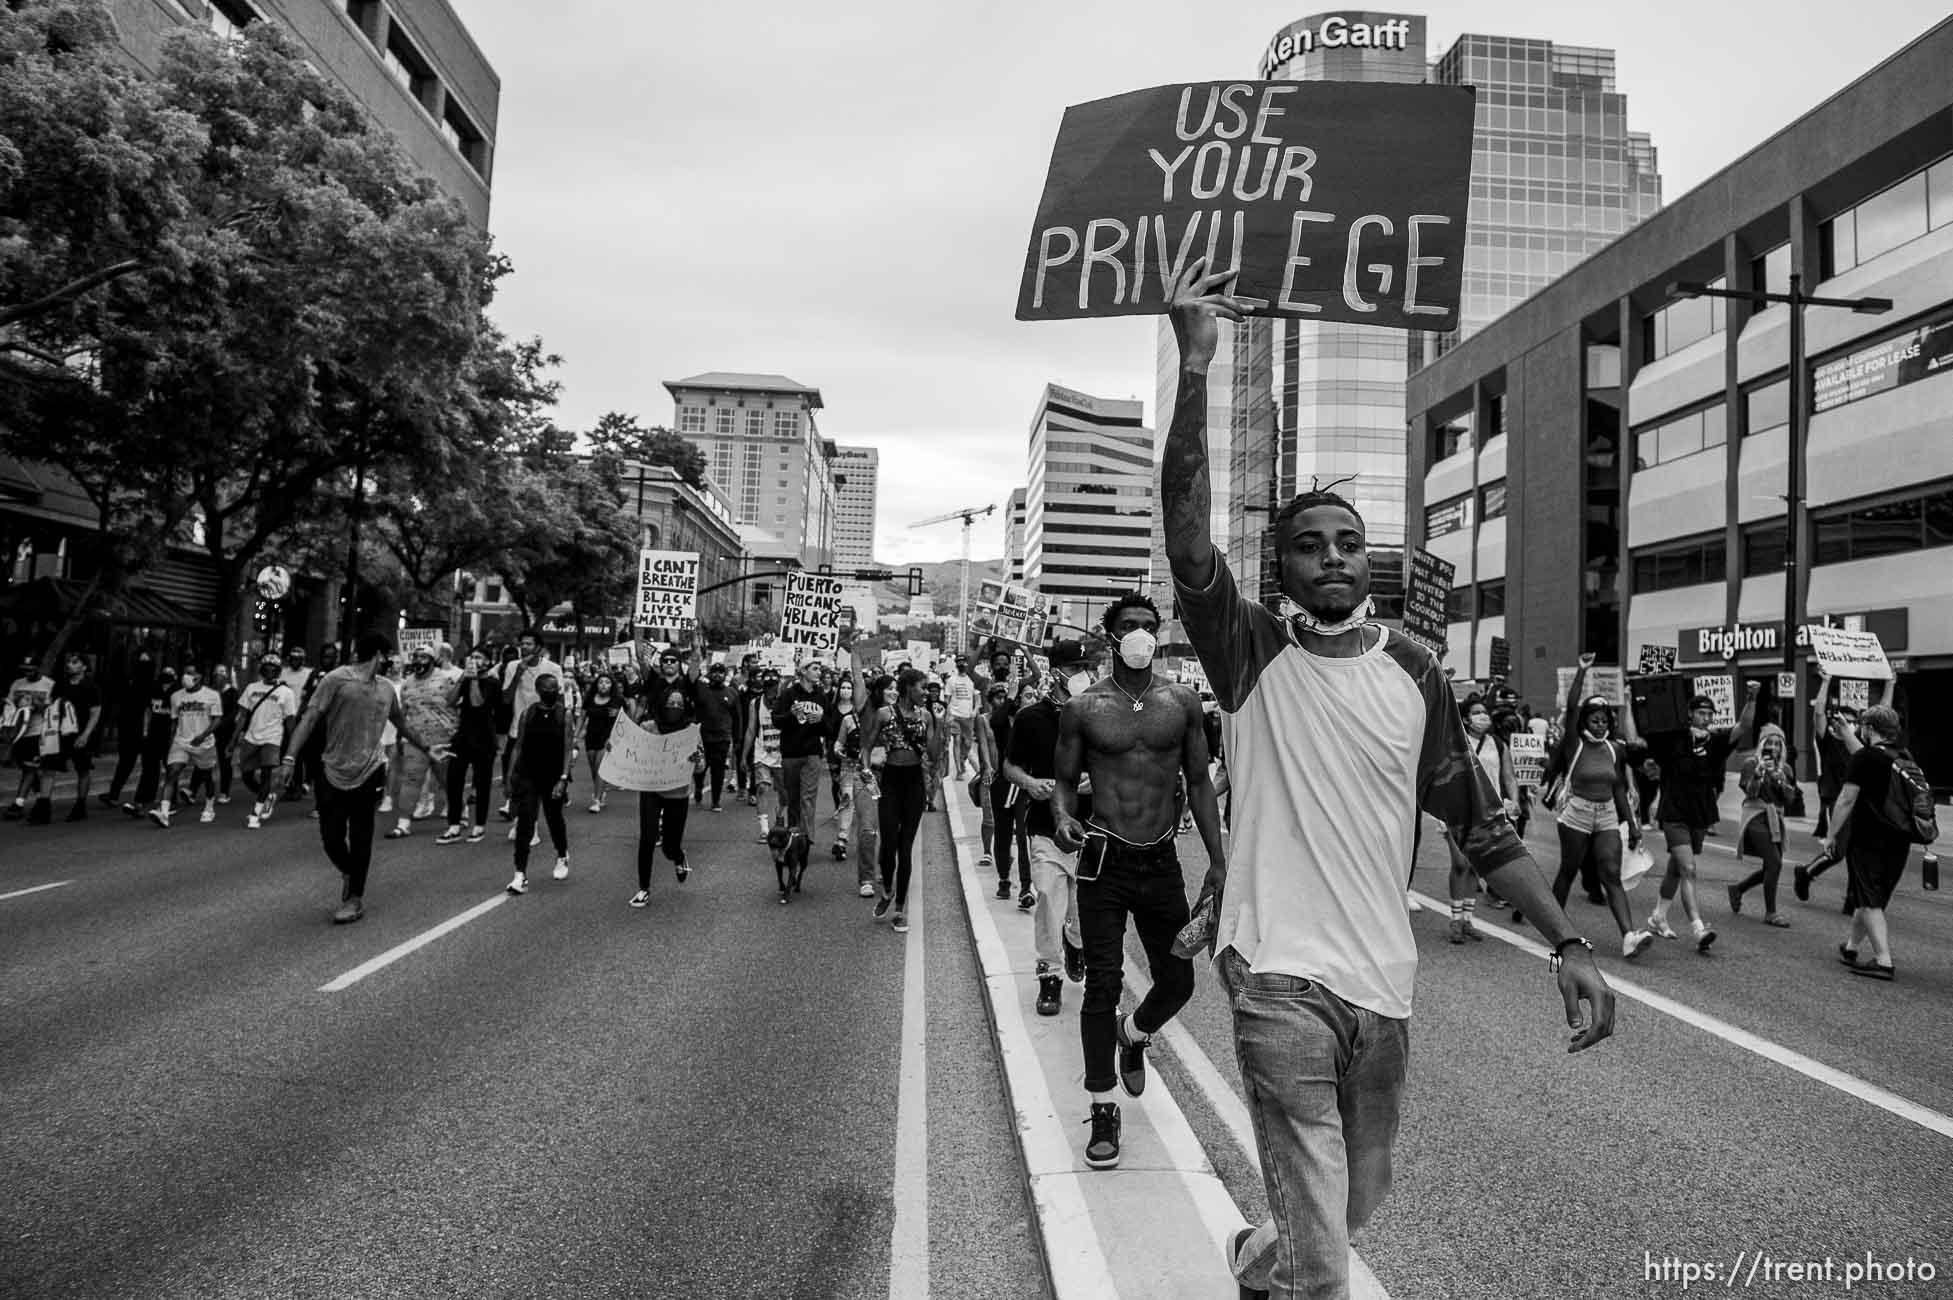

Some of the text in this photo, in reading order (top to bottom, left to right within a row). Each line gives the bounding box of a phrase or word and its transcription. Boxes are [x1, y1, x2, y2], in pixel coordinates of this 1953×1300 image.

[1265, 16, 1410, 72] Ken Garff
[1175, 82, 1299, 145] USE
[1147, 140, 1318, 202] YOUR
[1032, 209, 1451, 316] PRIVILEGE
[1864, 357, 1887, 374] FOR
[1887, 344, 1921, 367] LEASE
[642, 571, 695, 590] BREATHE
[787, 573, 843, 595] PUERTO
[643, 591, 691, 605] BLACK
[642, 603, 682, 617] LIVES
[1409, 600, 1445, 623] COOKOUT
[400, 631, 437, 640] CONVICT
[781, 625, 836, 650] LIVES!
[1698, 623, 1777, 660] Brighton
[1639, 659, 1672, 674] EYES
[1696, 677, 1733, 689] HANDS
[1513, 737, 1542, 748] BLACK
